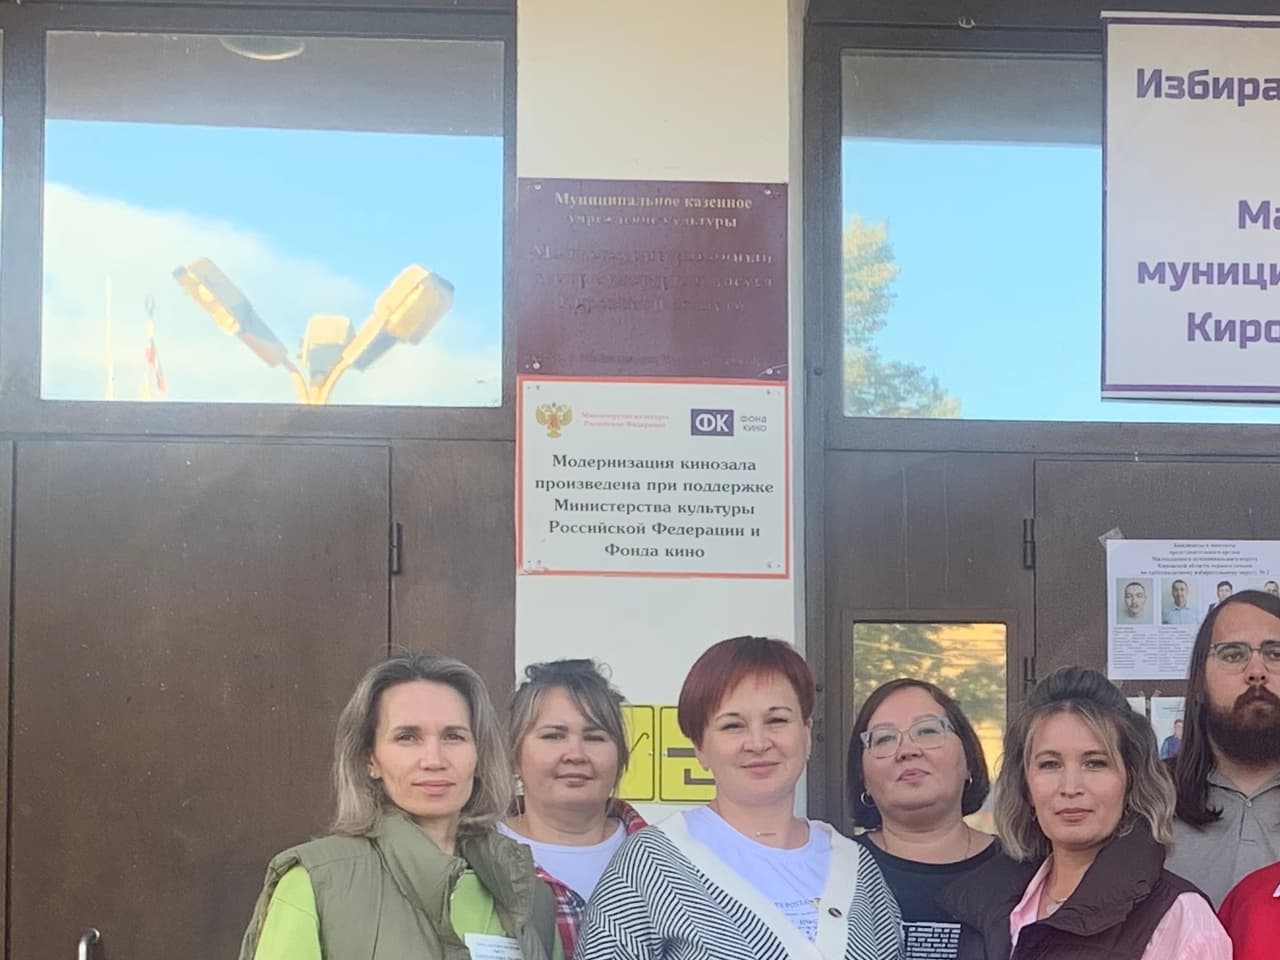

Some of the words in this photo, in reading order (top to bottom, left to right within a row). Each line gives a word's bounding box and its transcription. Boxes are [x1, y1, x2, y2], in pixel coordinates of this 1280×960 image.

[685, 197, 753, 210] казенное
[695, 413, 730, 433] ФК
[552, 454, 675, 471] Модернизация
[680, 458, 757, 471] кинозала
[535, 479, 641, 492] произведена
[647, 480, 677, 493] при
[683, 482, 774, 495] поддержке
[554, 498, 672, 515] Министерства
[677, 503, 756, 517] культуры
[549, 520, 646, 536] Российской
[652, 522, 745, 538] Федерации
[750, 527, 760, 537] и
[604, 543, 659, 557] Фонда
[665, 547, 705, 558] кино
